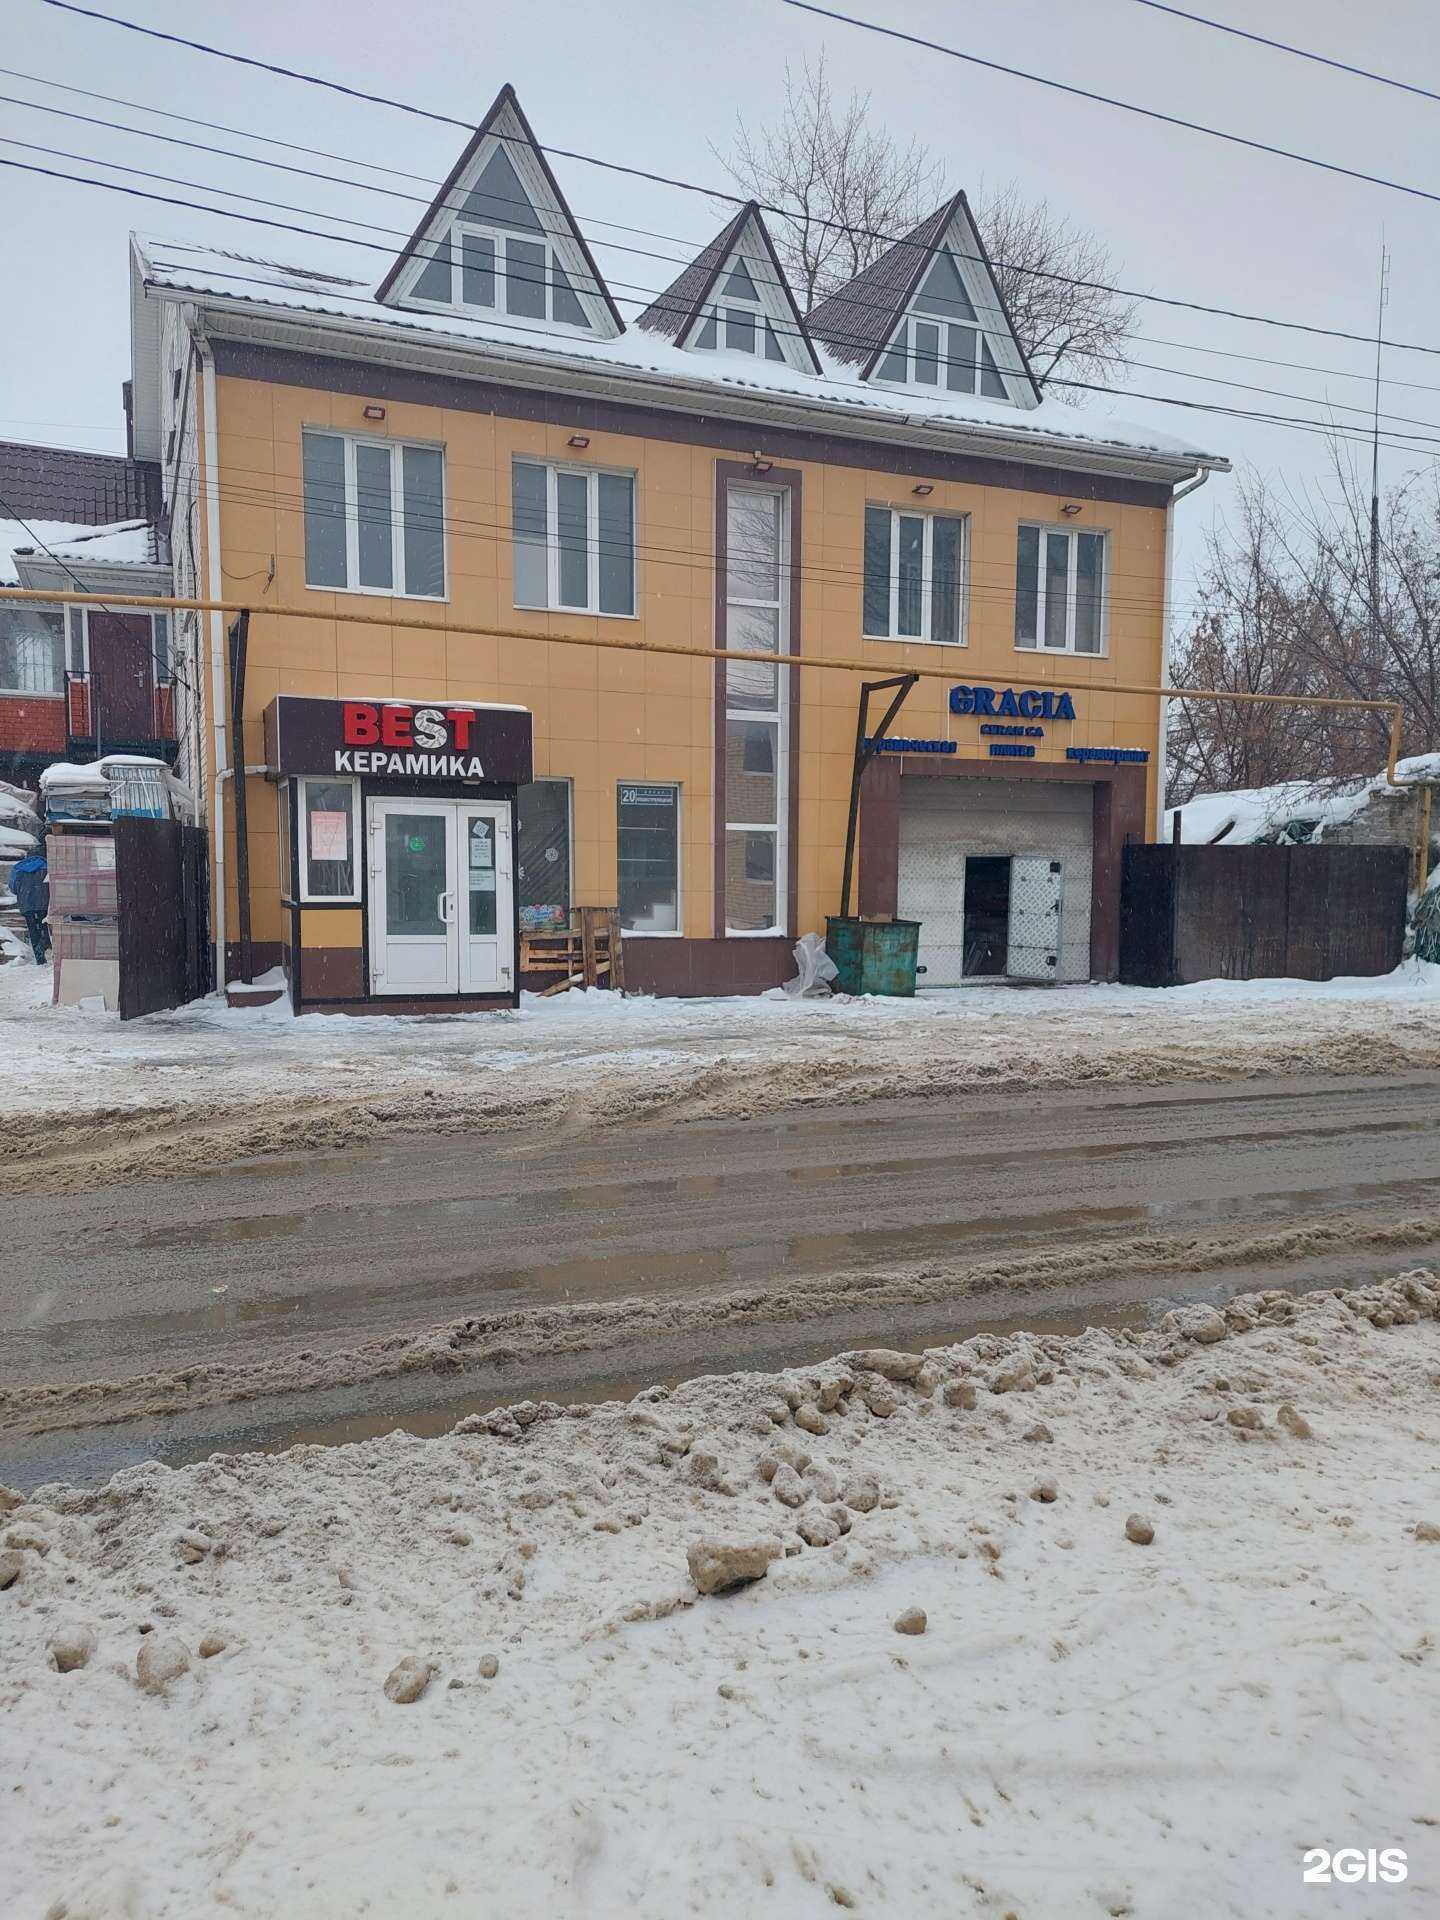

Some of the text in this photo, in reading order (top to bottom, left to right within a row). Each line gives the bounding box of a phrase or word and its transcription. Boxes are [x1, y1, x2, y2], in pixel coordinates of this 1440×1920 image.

[950, 685, 1076, 720] GRACIA
[343, 702, 477, 751] BEST
[863, 737, 958, 753] крамическая
[335, 750, 485, 778] КЕРАМИКА
[622, 789, 636, 802] 20
